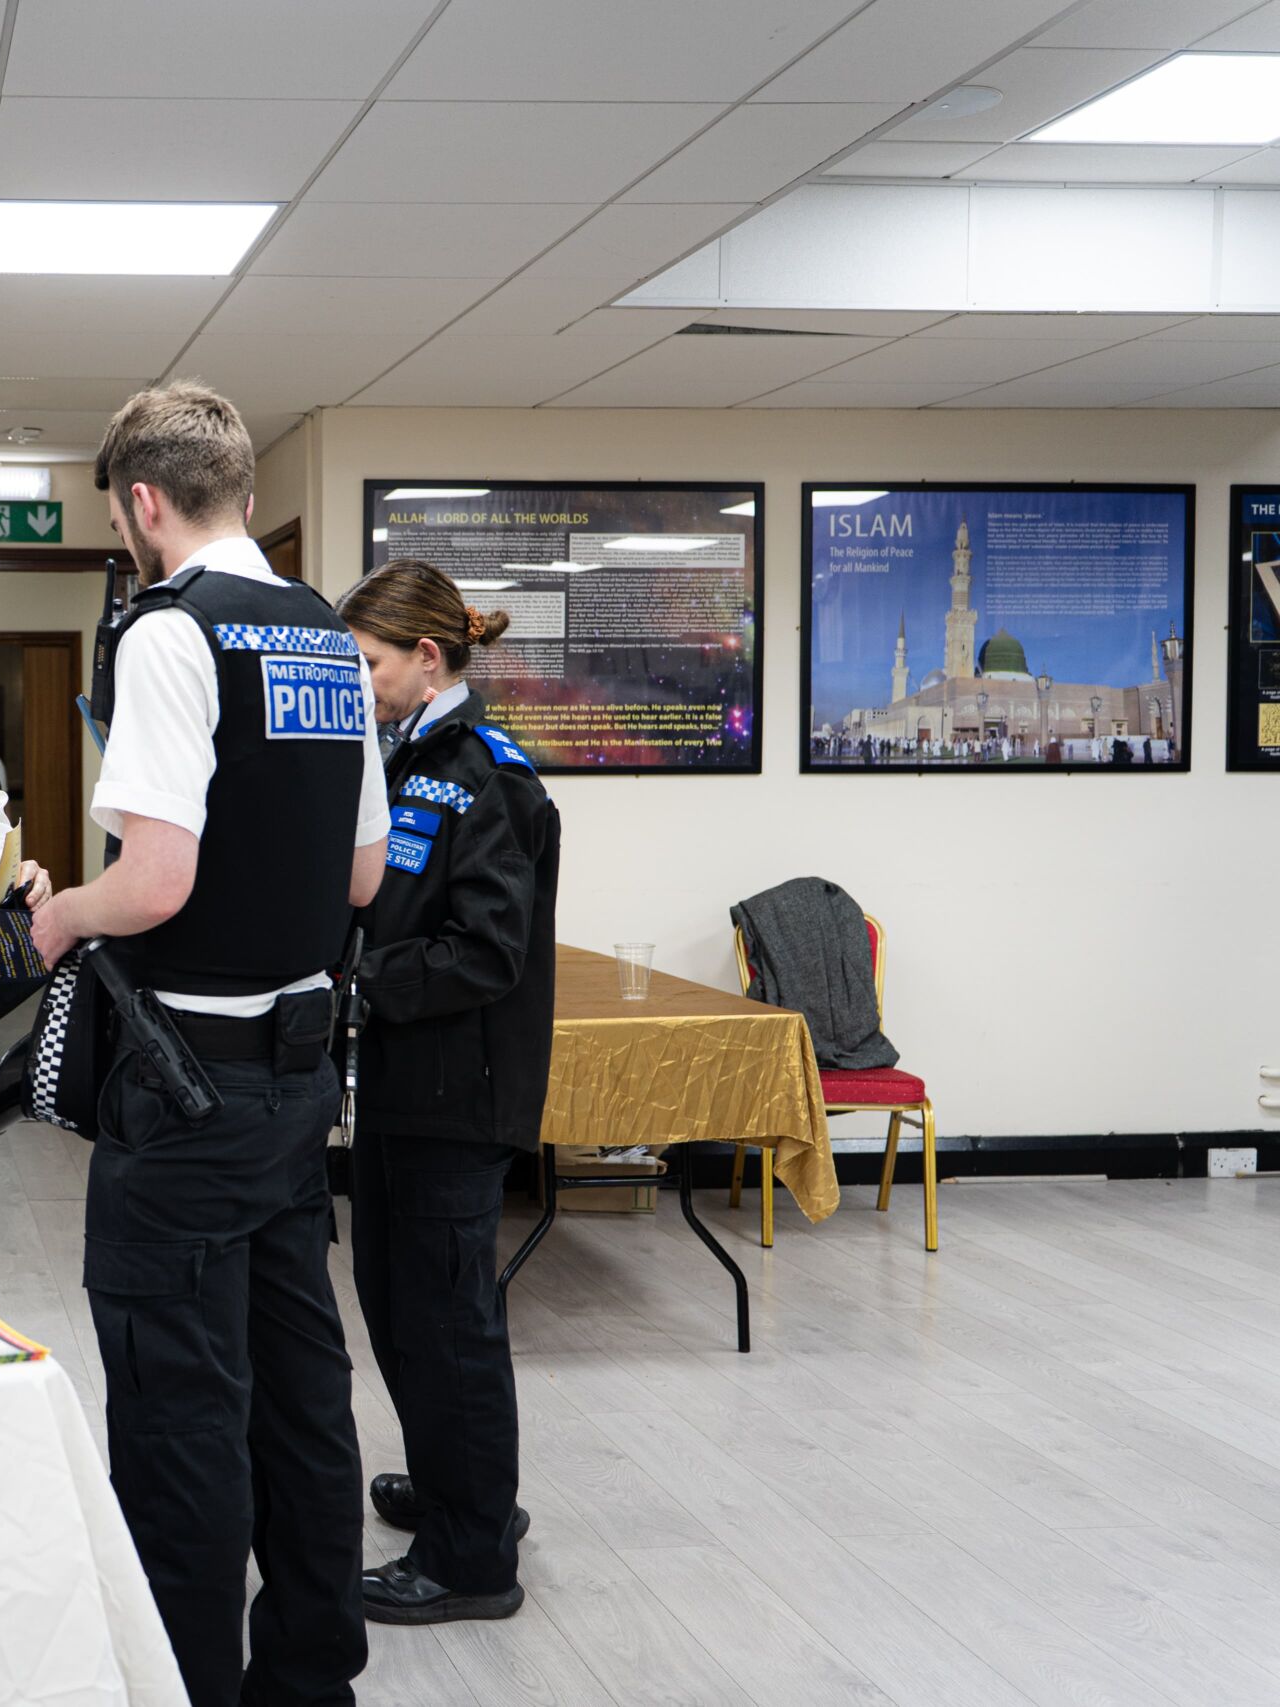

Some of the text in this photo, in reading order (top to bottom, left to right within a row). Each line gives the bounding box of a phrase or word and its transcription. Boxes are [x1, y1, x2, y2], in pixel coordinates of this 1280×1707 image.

[1251, 504, 1276, 515] THE
[388, 513, 427, 524] ALLAH
[436, 513, 469, 524] LORD
[471, 513, 487, 524] OF
[490, 513, 511, 524] ALL
[514, 513, 537, 524] THE
[539, 513, 589, 524] WORLDS
[829, 514, 913, 537] ISLAM
[830, 546, 914, 559] The Religion of Peace
[830, 562, 890, 573] for all Mankind
[272, 664, 361, 684] METROPOLITAN
[272, 685, 365, 731] POLICE
[491, 704, 507, 712] who
[508, 704, 515, 712] is
[516, 704, 533, 712] alive
[534, 704, 552, 712] even
[553, 704, 569, 712] now
[570, 704, 578, 712] as
[580, 704, 590, 712] He
[591, 704, 605, 712] was
[606, 704, 623, 712] alive
[625, 704, 650, 712] before.
[652, 704, 662, 712] He
[663, 704, 687, 713] speaks
[688, 704, 706, 712] even
[707, 704, 722, 712] now
[511, 723, 527, 731] does
[529, 723, 545, 731] hear
[545, 723, 559, 731] but
[560, 723, 577, 731] does
[578, 723, 590, 731] not
[591, 723, 613, 732] speak.
[614, 723, 627, 731] But
[628, 723, 638, 731] He
[639, 723, 658, 731] hears
[659, 723, 673, 731] and
[674, 723, 699, 732] speaks,
[684, 739, 705, 748] every
[390, 843, 417, 857] POLICE
[394, 855, 421, 869] STAFF
